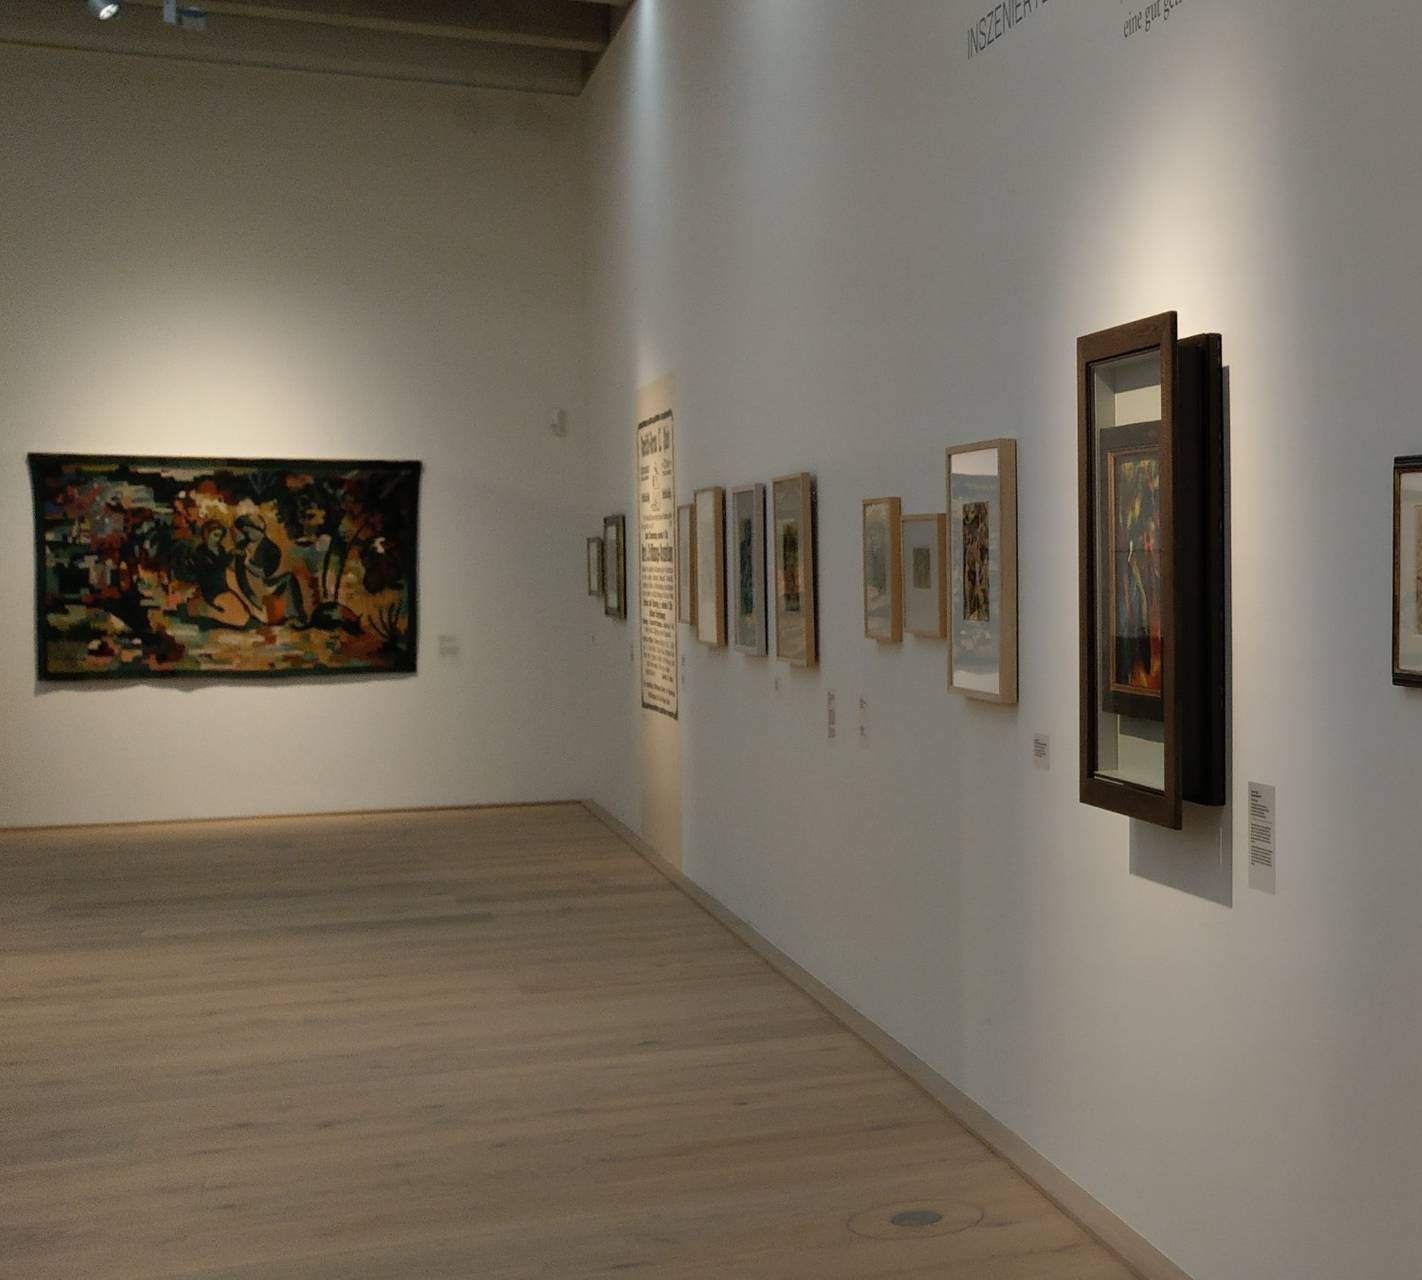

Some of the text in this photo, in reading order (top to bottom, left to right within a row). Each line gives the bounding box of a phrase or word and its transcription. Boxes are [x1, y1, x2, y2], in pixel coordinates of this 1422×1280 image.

[967, 0, 1048, 60] INSZENIER
[1123, 11, 1142, 38] eine
[1144, 0, 1161, 32] gut
